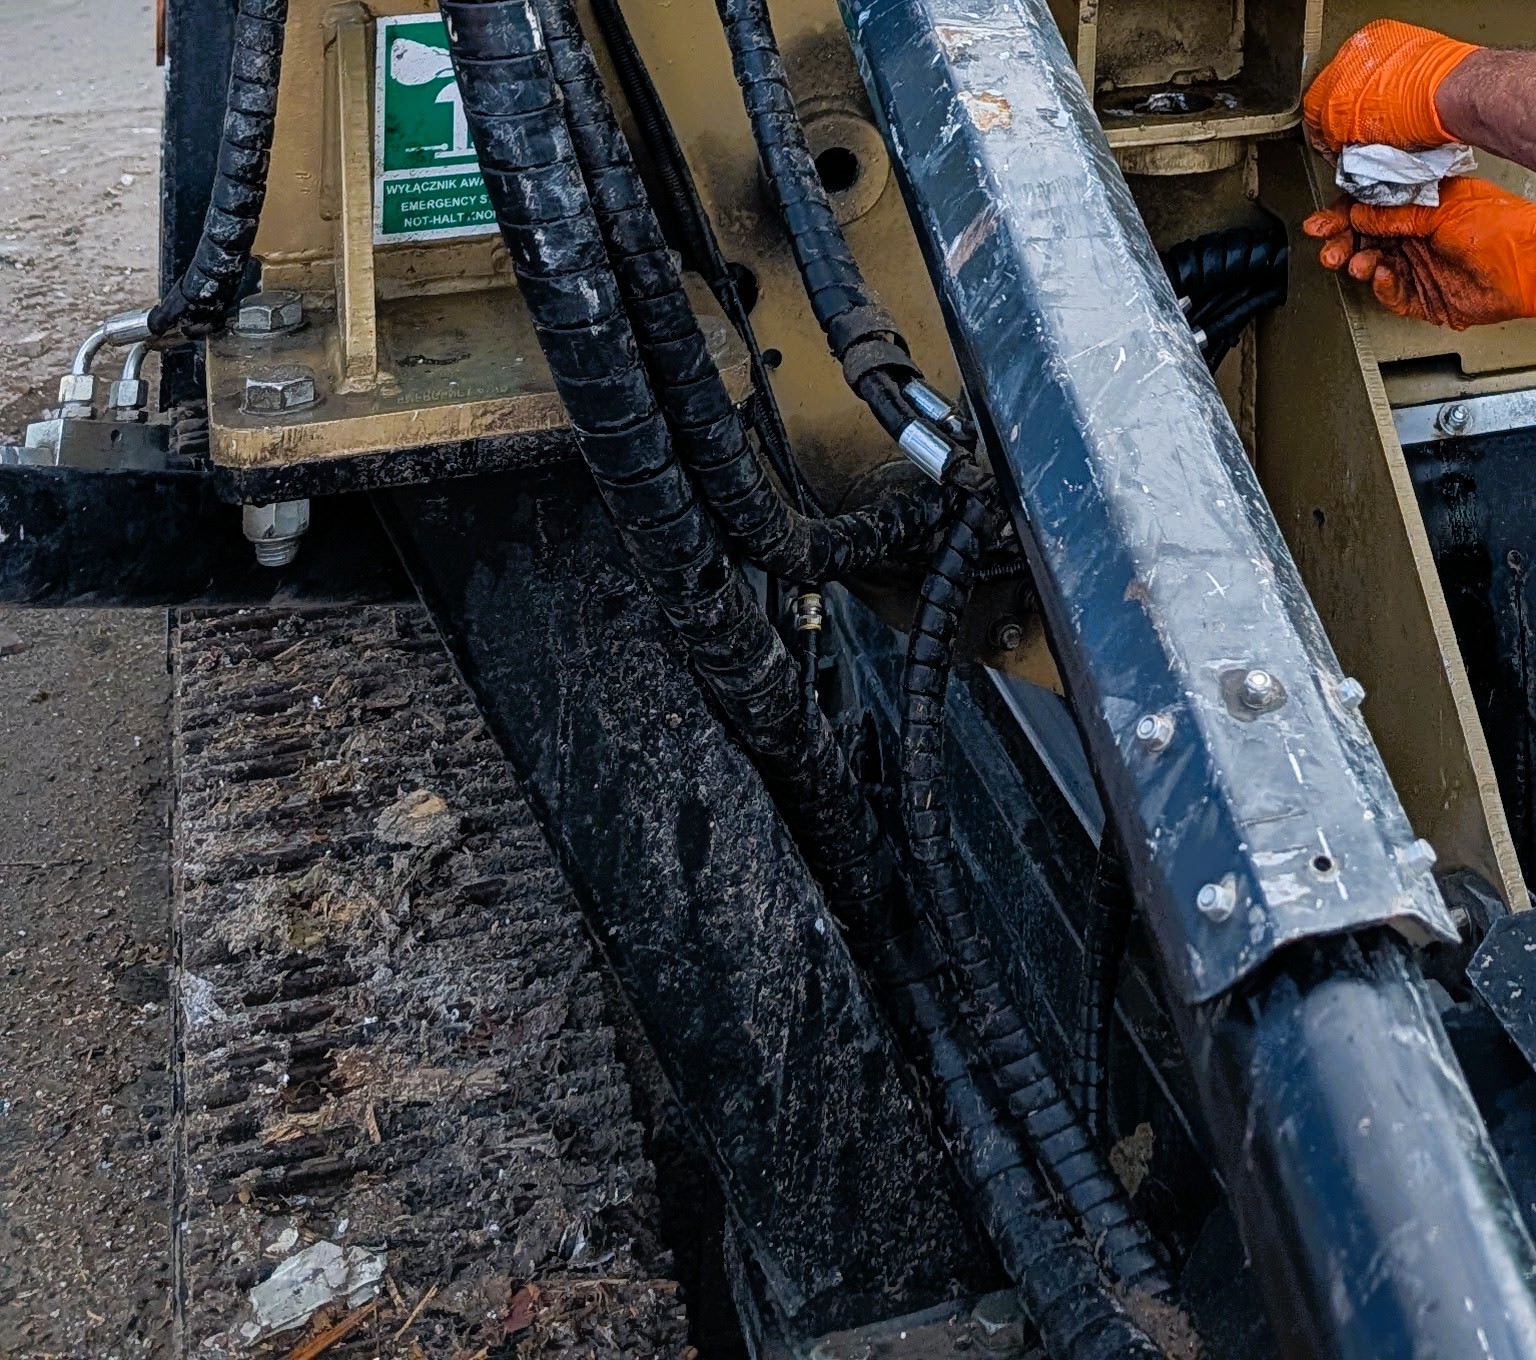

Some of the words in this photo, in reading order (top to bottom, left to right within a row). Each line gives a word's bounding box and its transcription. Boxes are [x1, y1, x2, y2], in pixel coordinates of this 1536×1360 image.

[386, 179, 457, 195] WYŁĄCZNIK
[401, 195, 477, 212] EMERGENCY
[403, 212, 465, 228] NOT-HALT
